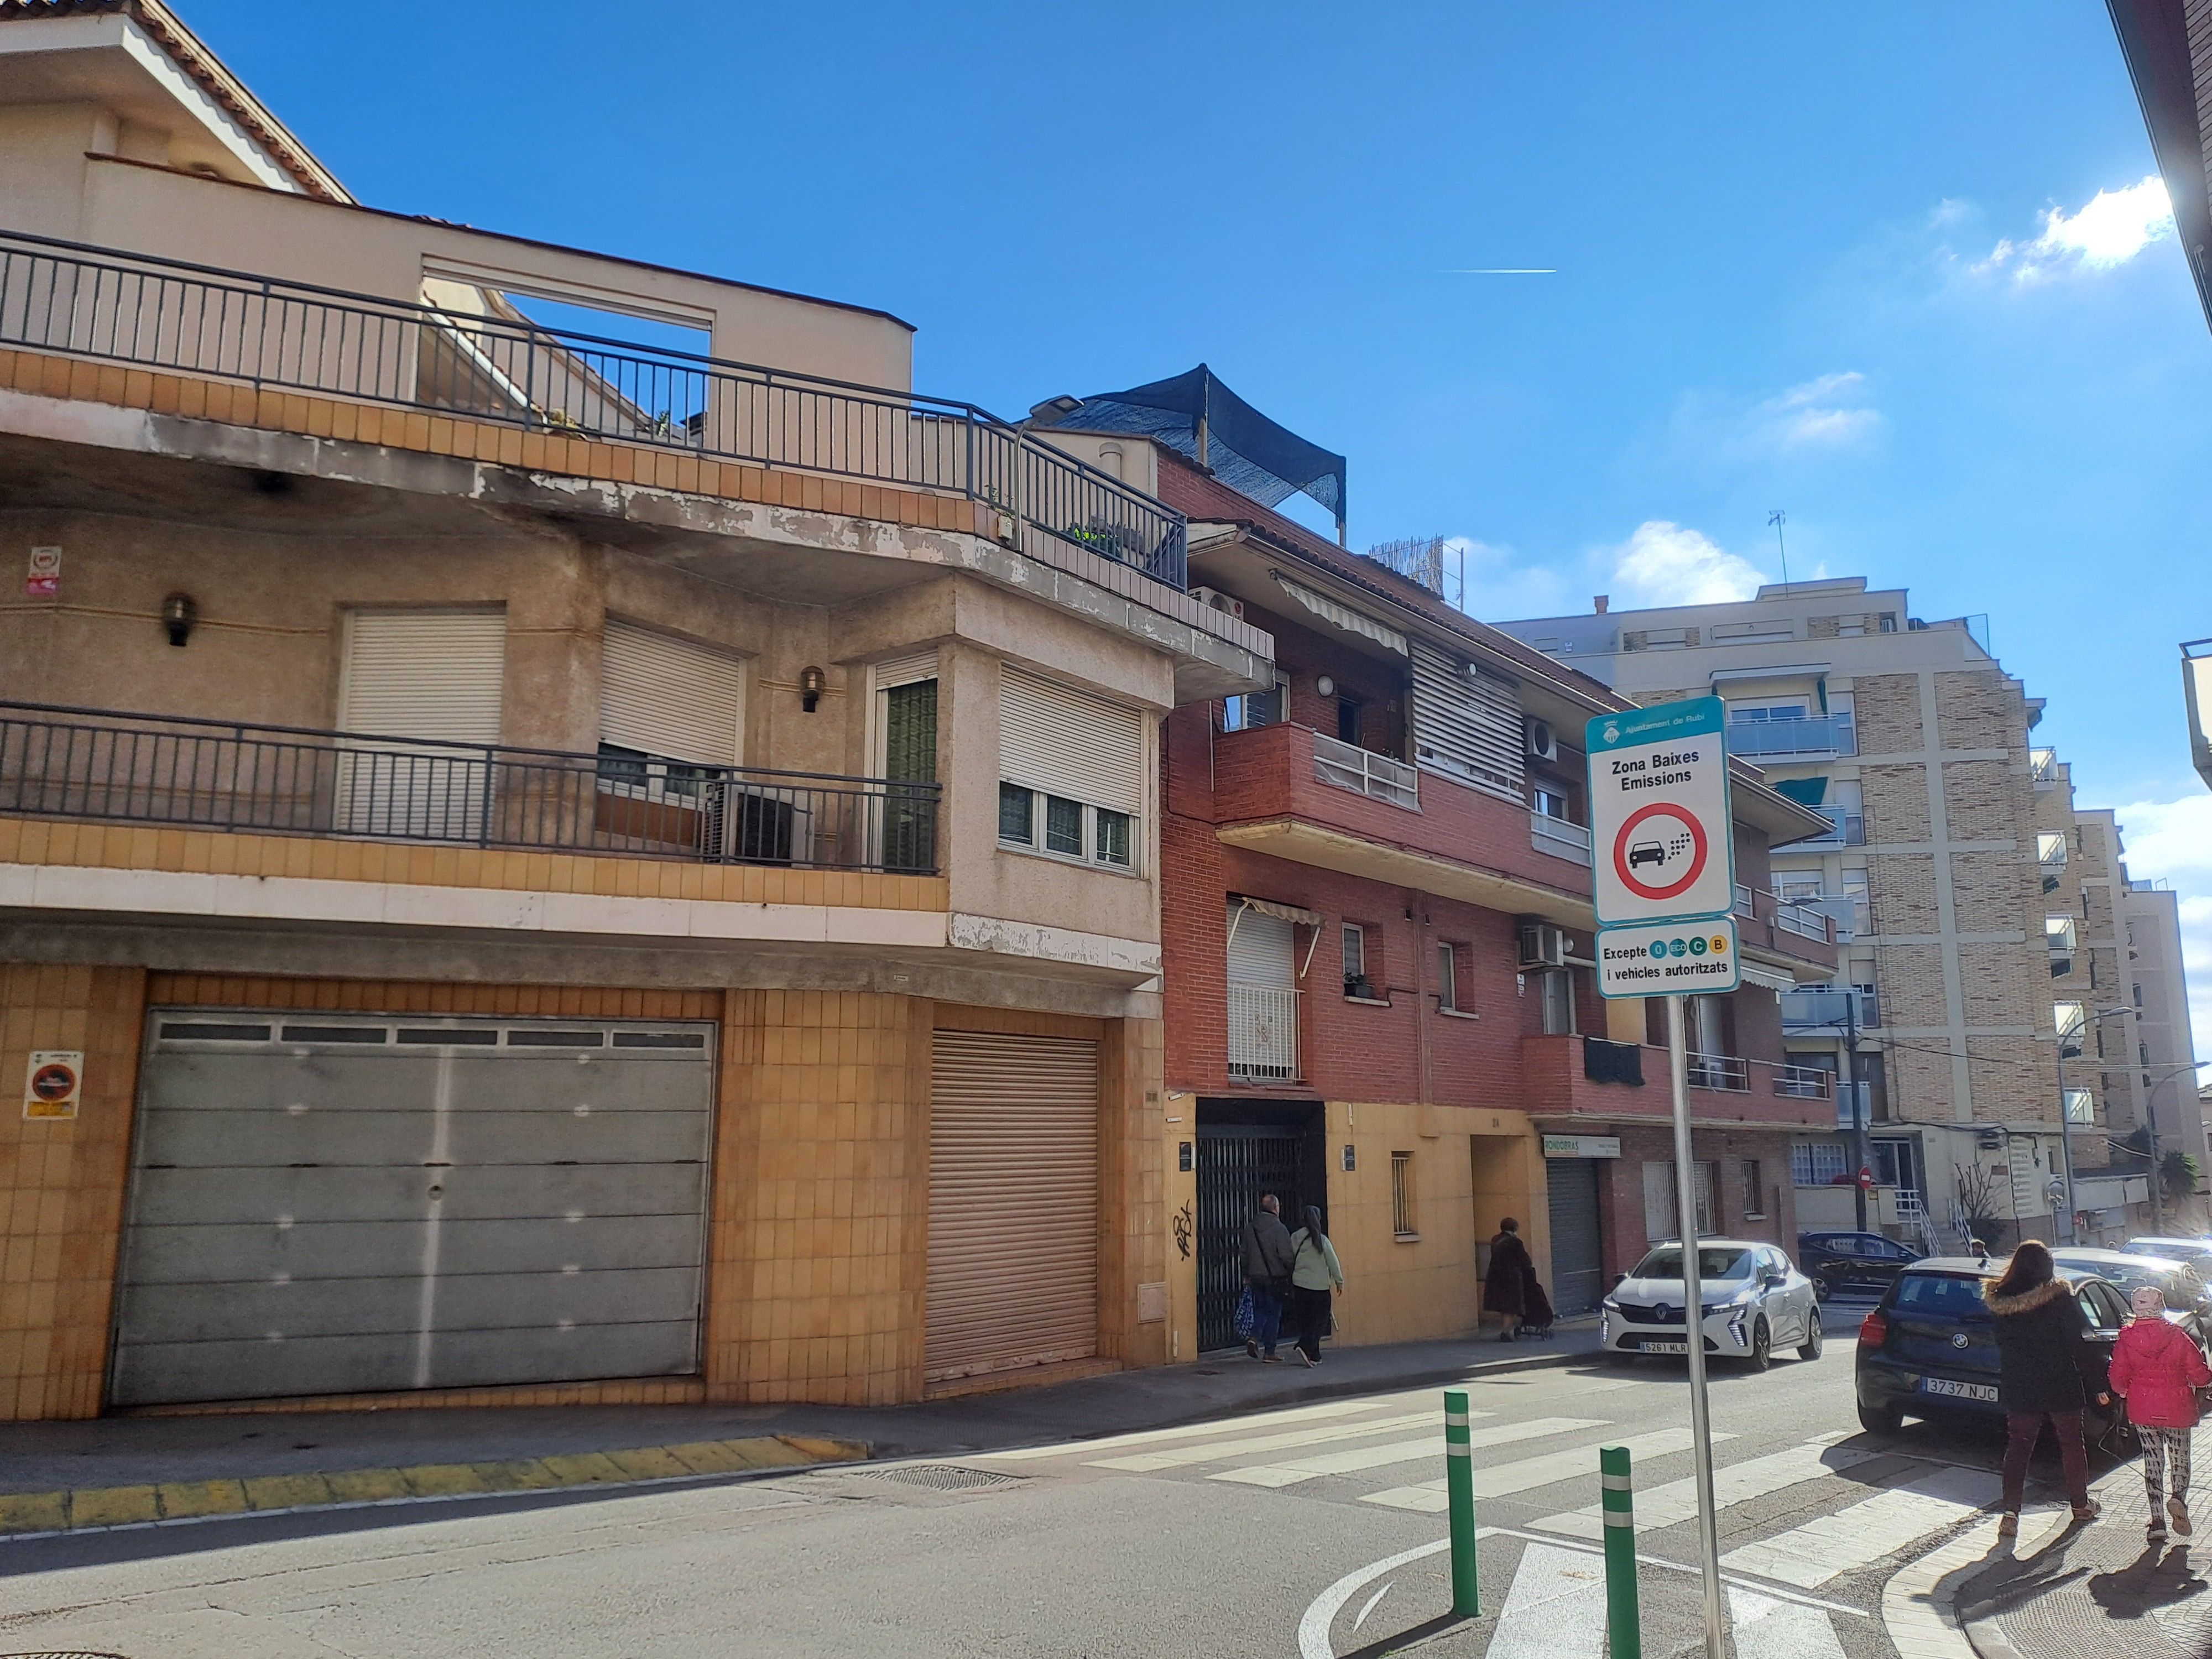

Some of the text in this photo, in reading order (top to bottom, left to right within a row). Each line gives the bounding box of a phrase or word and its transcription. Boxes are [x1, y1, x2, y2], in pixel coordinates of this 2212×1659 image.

[1625, 719, 1670, 734] Ajuntament
[1673, 717, 1684, 725] de
[1612, 751, 1699, 775] Zona Baixes
[1621, 770, 1692, 791] Emissions
[1603, 946, 1647, 961] Excepte
[1693, 941, 1703, 952] C
[1714, 939, 1723, 950] B
[1608, 961, 1728, 981] i vehicles autoritzats
[1646, 1343, 1686, 1353] 5261 MLR
[1930, 1380, 1995, 1400] 3737 NJC
